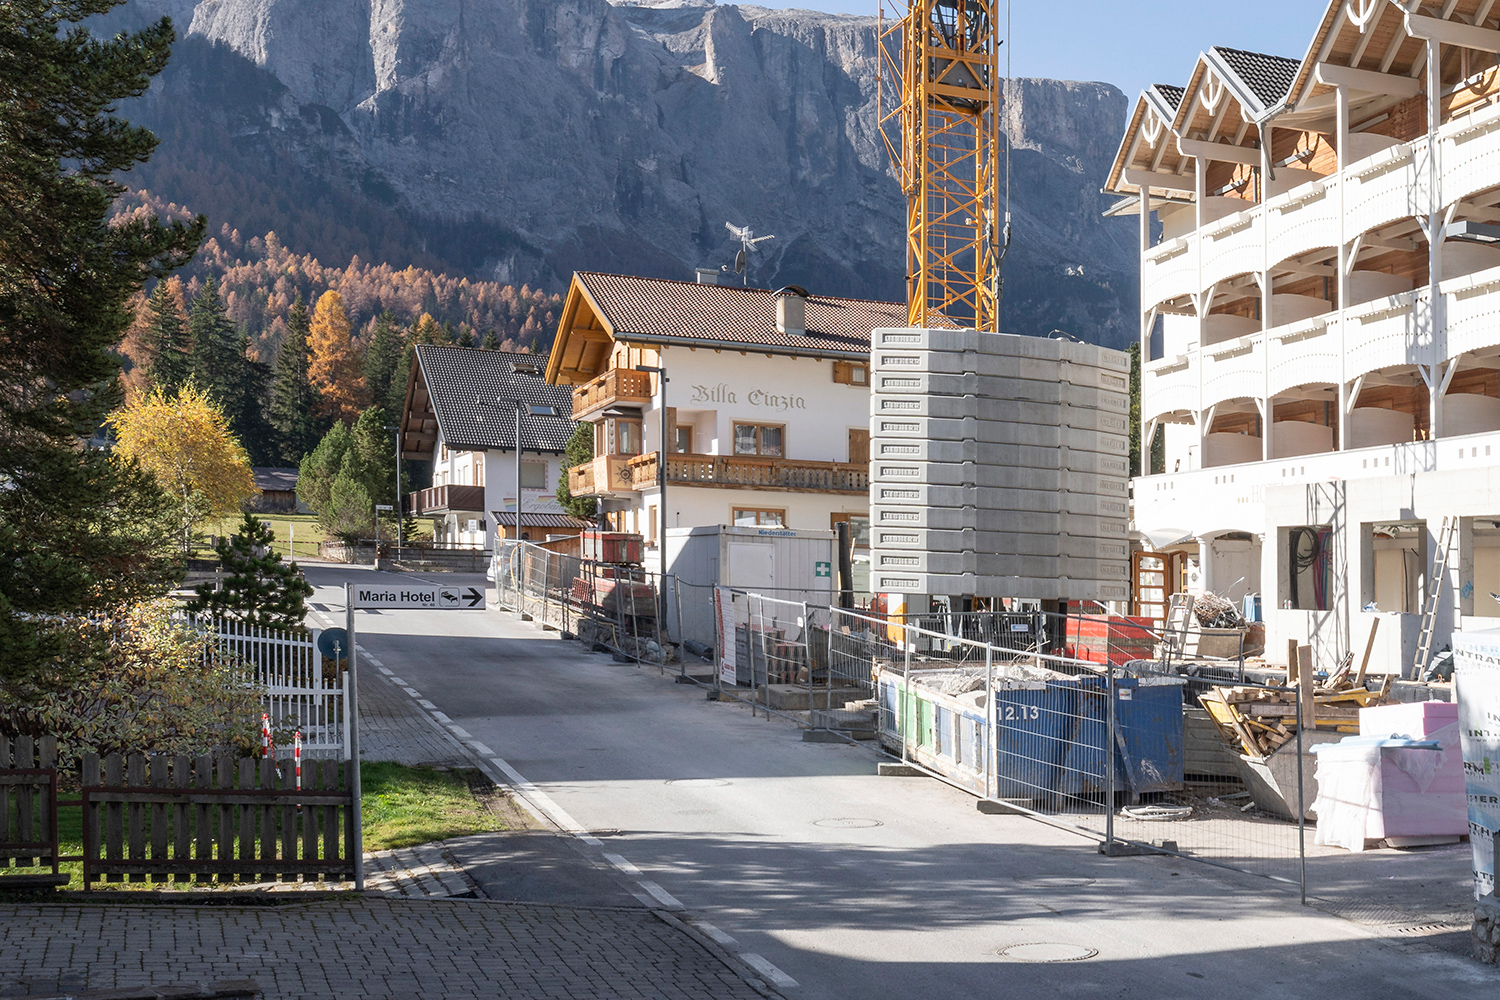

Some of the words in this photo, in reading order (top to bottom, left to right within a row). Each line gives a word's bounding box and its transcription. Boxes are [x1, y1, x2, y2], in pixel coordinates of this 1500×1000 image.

[690, 383, 738, 405] Villa
[360, 591, 396, 602] Maria
[400, 591, 435, 602] Hotel
[997, 705, 1039, 720] 12.13
